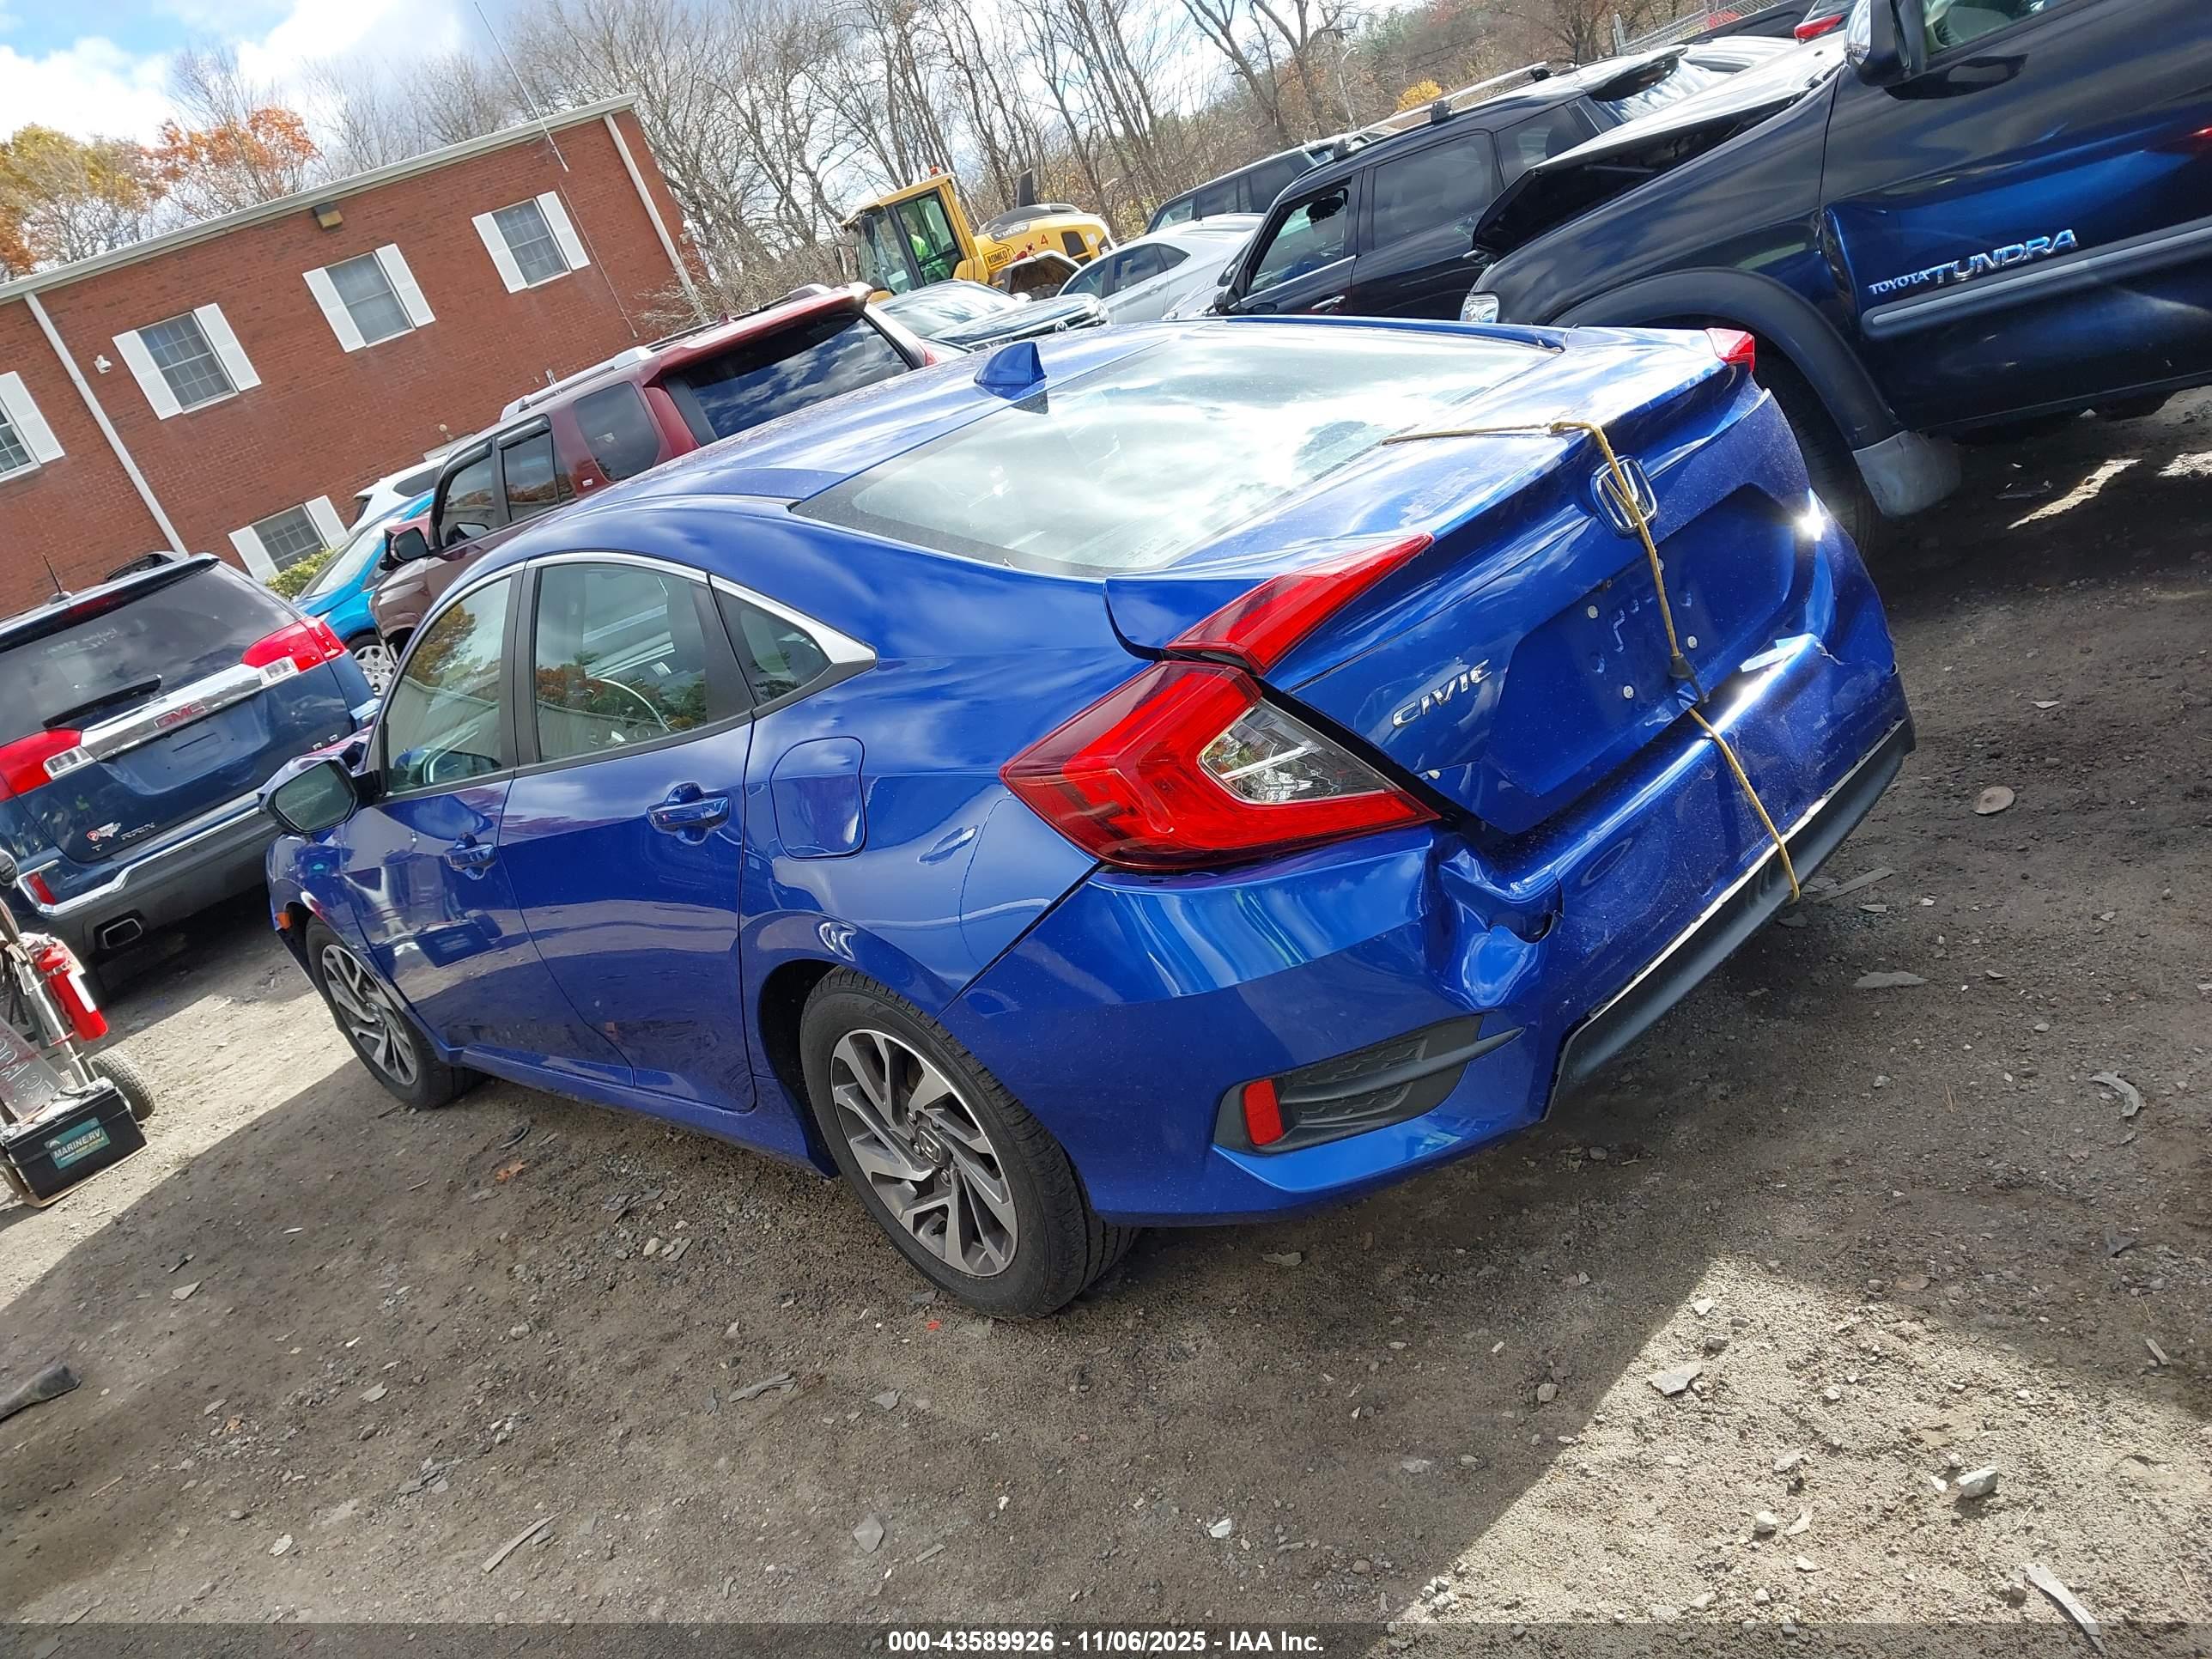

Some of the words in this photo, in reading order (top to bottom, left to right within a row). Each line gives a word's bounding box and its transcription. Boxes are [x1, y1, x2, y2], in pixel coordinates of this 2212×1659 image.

[994, 225, 1027, 238] VOLVO
[1040, 234, 1049, 246] 4
[1869, 269, 1930, 295] TOYOTA
[1929, 229, 2078, 284] TUNDRA
[1392, 659, 1492, 727] CIVIC
[154, 700, 207, 728] GMC
